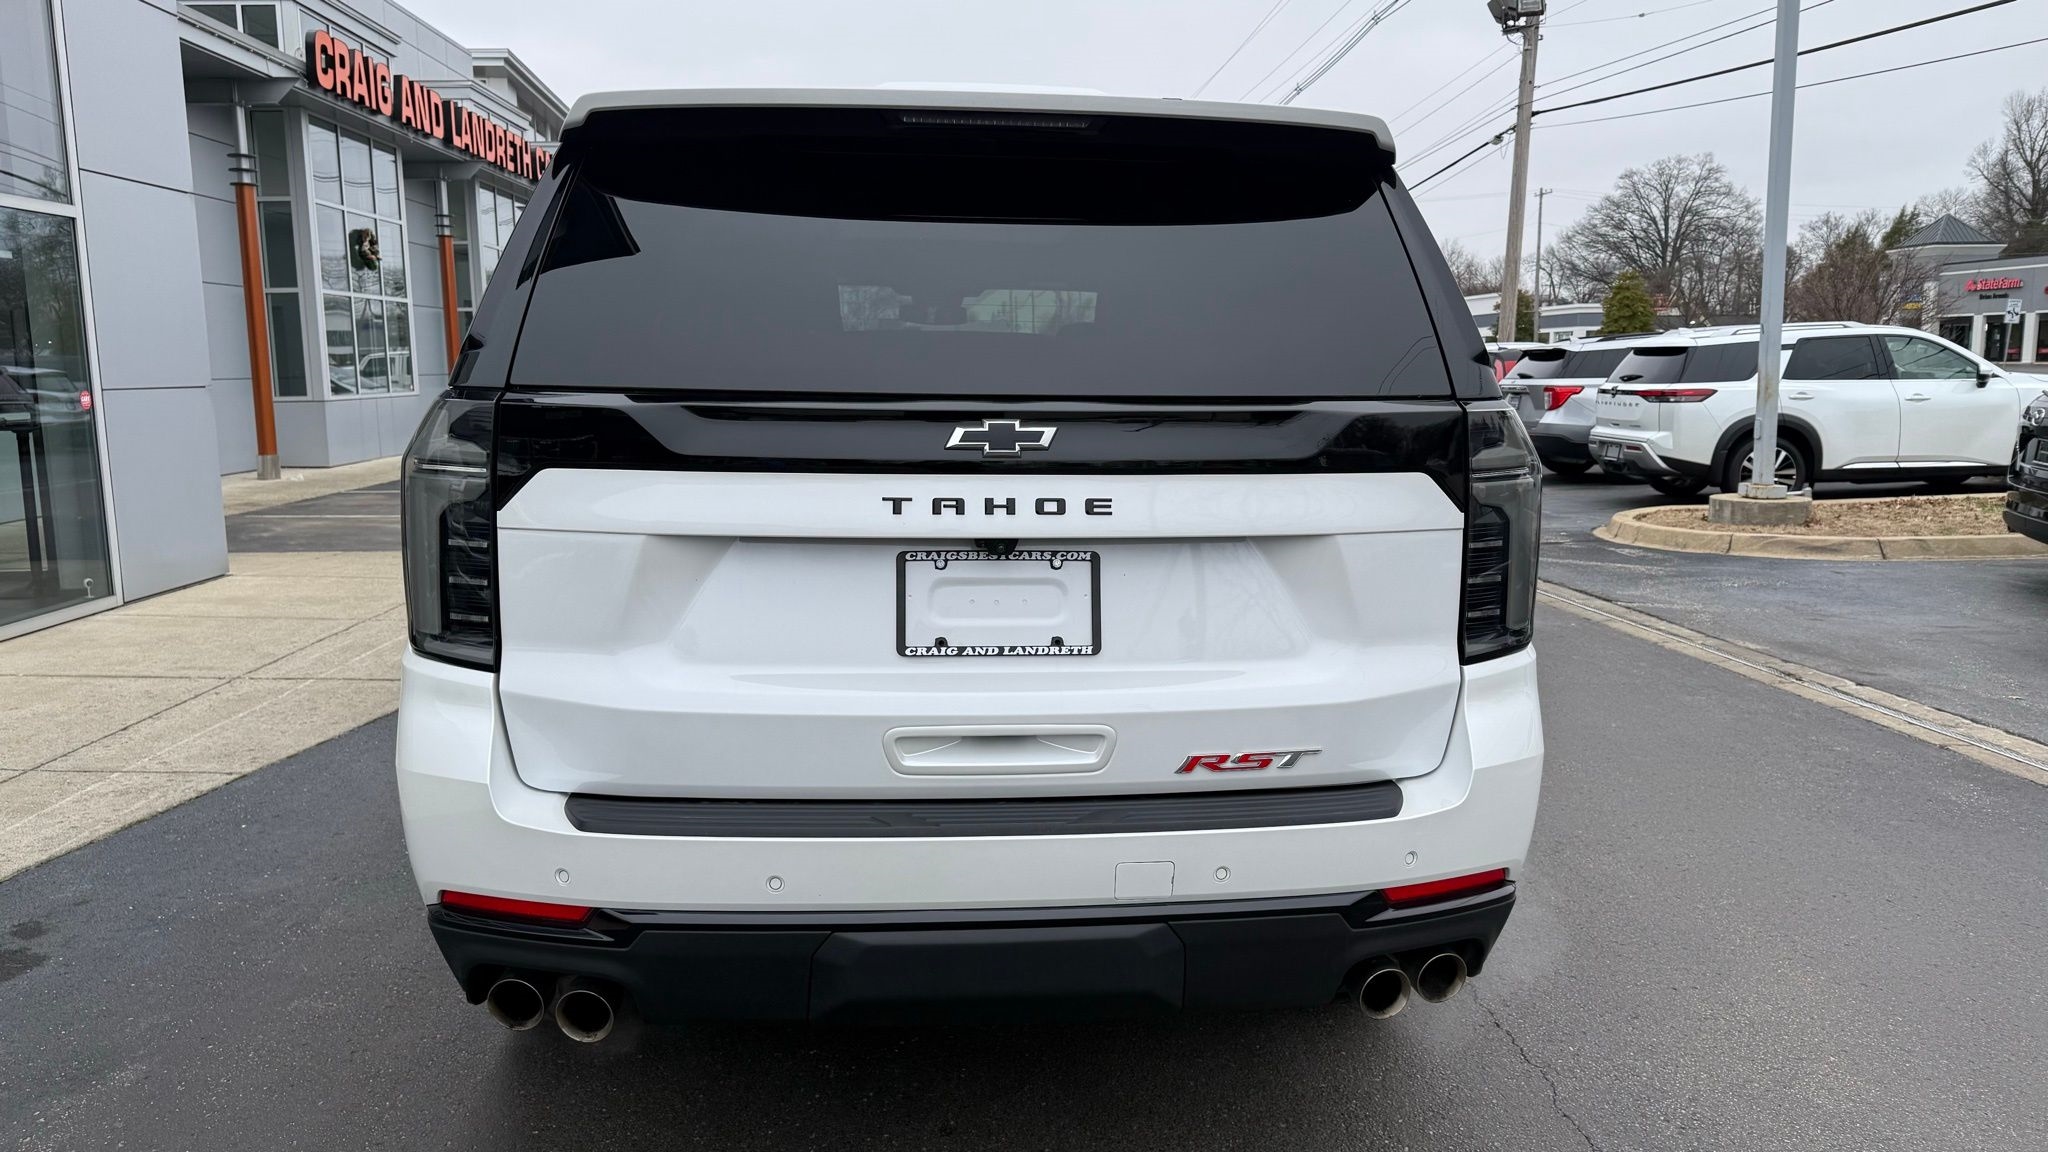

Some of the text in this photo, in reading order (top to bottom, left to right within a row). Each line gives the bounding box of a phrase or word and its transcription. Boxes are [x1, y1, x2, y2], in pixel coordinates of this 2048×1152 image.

[310, 29, 551, 181] CRAIG AND LANDRETH C
[881, 496, 1113, 516] TAHOE
[904, 645, 1094, 656] CRAIG AND LANDRETH
[1174, 748, 1323, 775] RST
